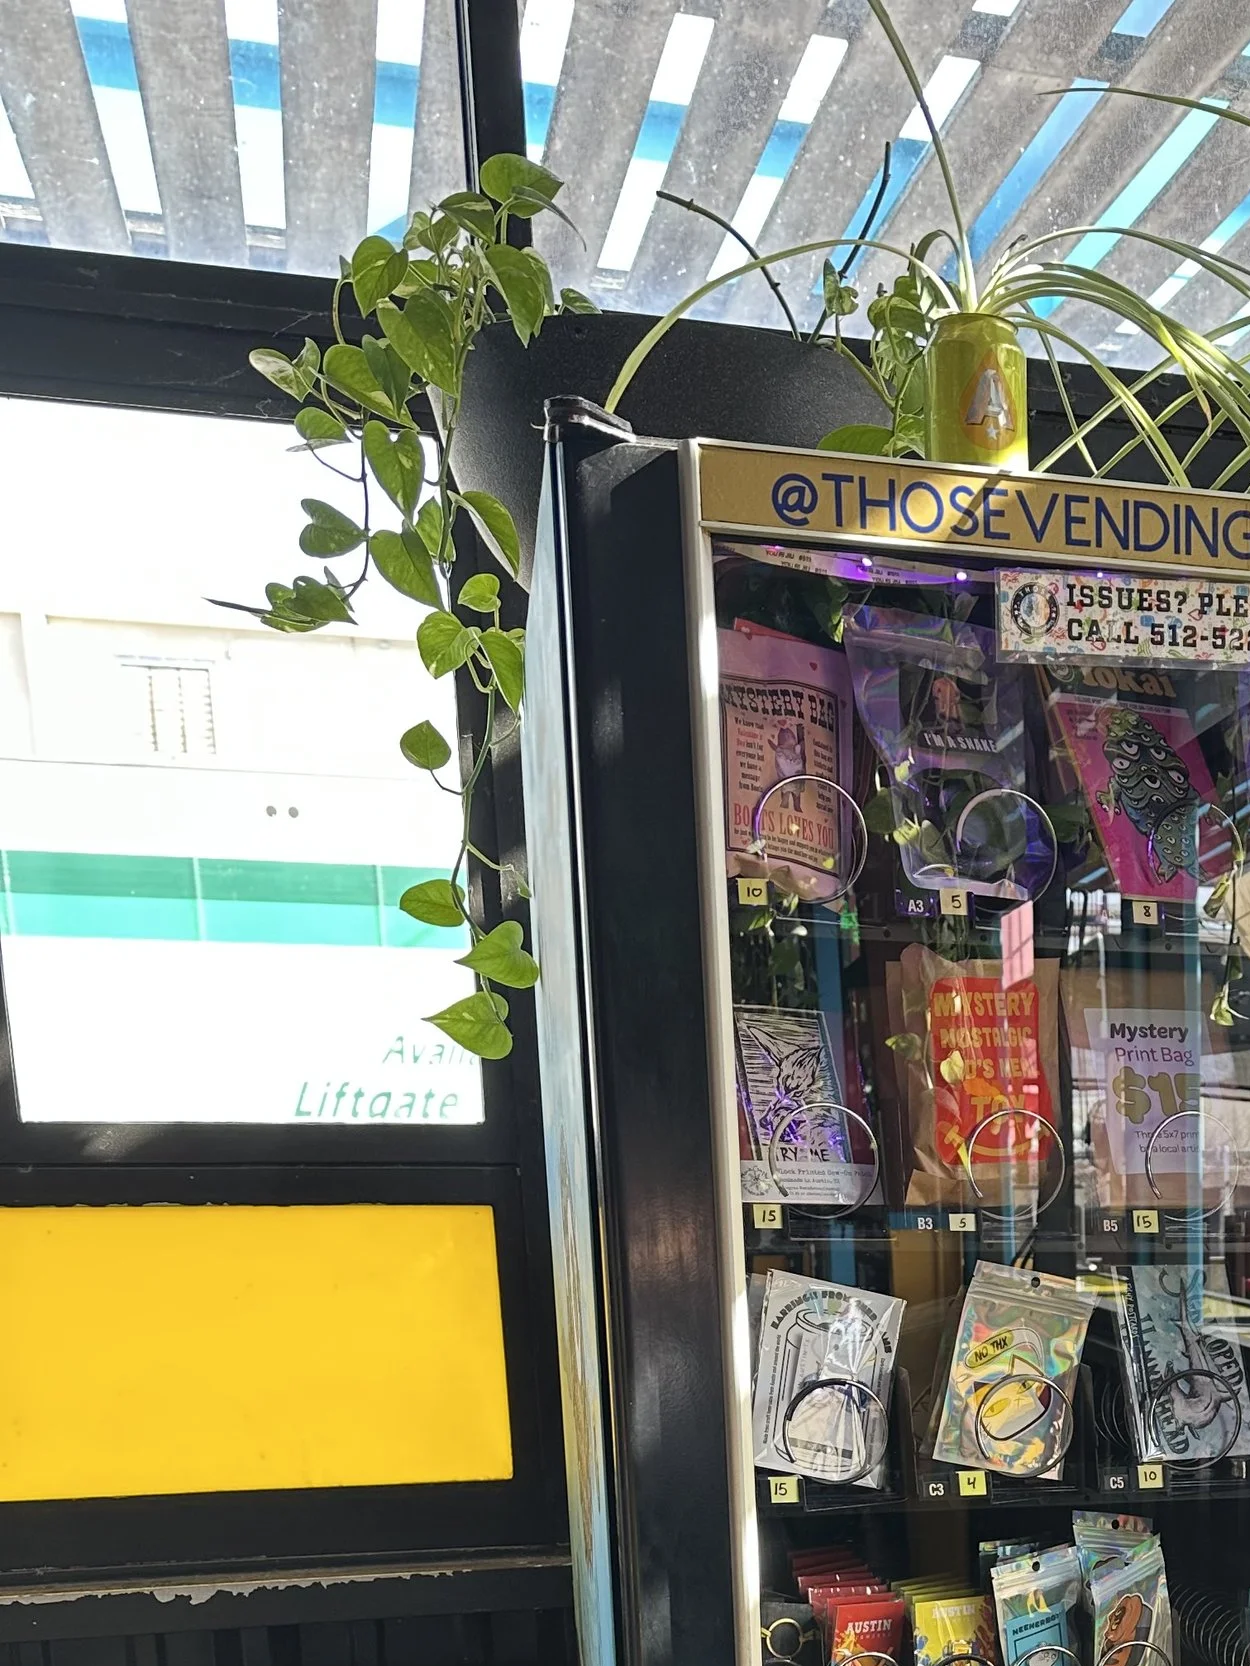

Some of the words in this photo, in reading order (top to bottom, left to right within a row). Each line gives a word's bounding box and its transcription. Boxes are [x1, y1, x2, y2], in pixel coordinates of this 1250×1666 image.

[1065, 583, 1188, 613] ISSUES?
[1066, 618, 1141, 646] CALL
[721, 684, 804, 719] MYSTERY
[808, 694, 834, 732] BAG
[923, 731, 945, 748] I'M
[957, 735, 998, 752] SNAKE
[734, 803, 774, 833] BOTS
[817, 823, 834, 850] YOU
[747, 886, 762, 898] 10
[907, 899, 924, 912] A3
[951, 895, 962, 909] 5
[1143, 905, 1152, 918] 8
[933, 992, 1035, 1017] MYSTERY
[1110, 1022, 1189, 1043] Mystery
[1115, 1045, 1158, 1062] Print
[1161, 1046, 1195, 1066] Bag
[1112, 1066, 1203, 1125] $15
[1163, 1130, 1179, 1139] 5x7
[809, 1148, 830, 1161] ME
[1160, 1144, 1180, 1153] local
[762, 1209, 776, 1222] 15
[1137, 1215, 1152, 1228] 15
[917, 1217, 933, 1230] B3
[958, 1218, 967, 1229] 5
[1103, 1219, 1118, 1232] B5
[974, 1346, 989, 1363] NO
[990, 1335, 1009, 1354] THX
[1109, 1476, 1125, 1489] C5
[1144, 1470, 1157, 1482] 10
[773, 1482, 788, 1496] 15
[928, 1483, 945, 1496] C3
[967, 1476, 976, 1490] 4
[846, 1619, 893, 1634] AUSTIN
